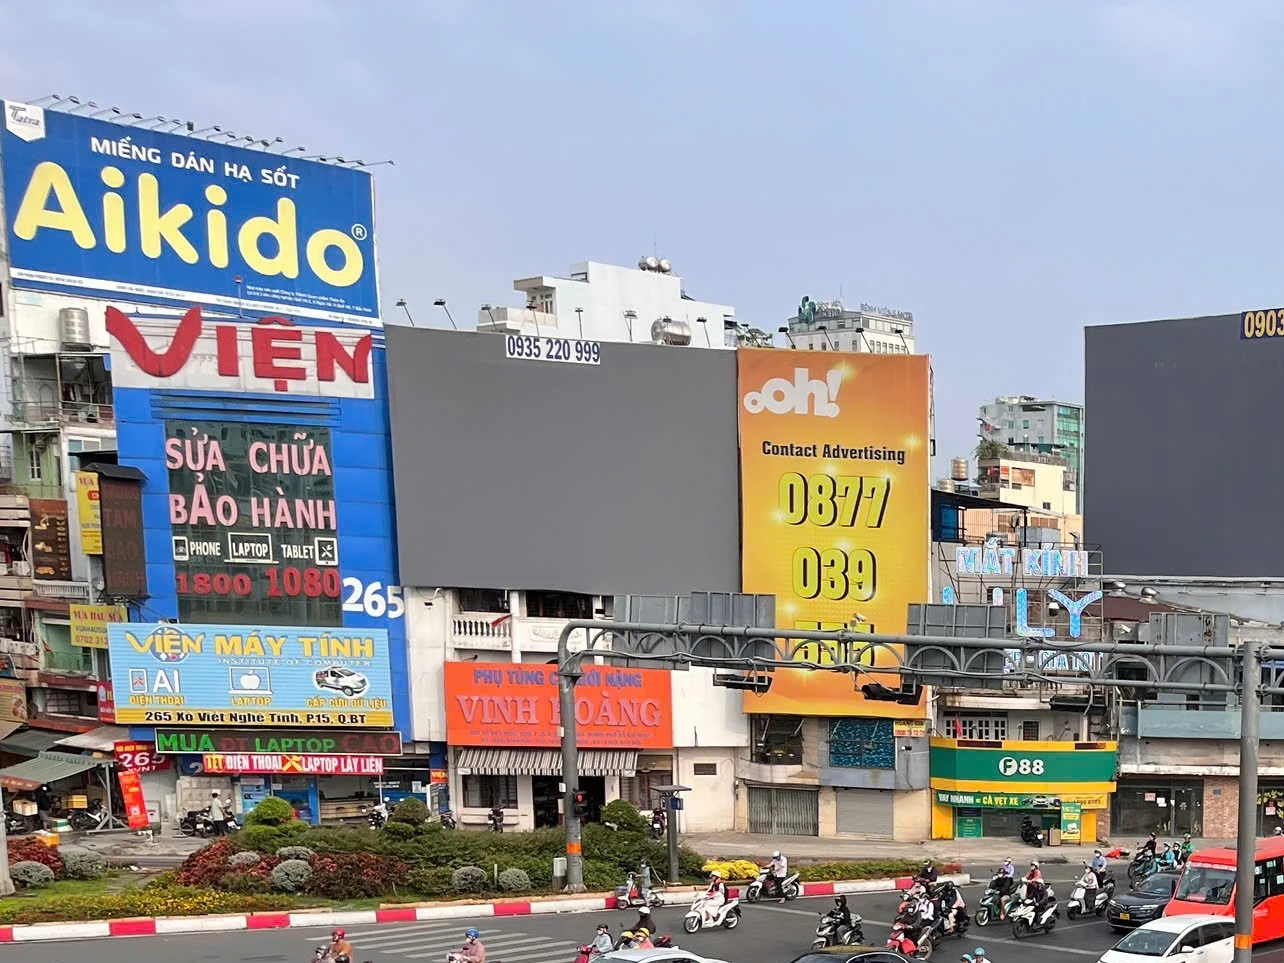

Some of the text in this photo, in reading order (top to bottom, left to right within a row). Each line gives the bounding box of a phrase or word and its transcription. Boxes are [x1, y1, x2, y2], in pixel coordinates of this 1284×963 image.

[90, 136, 300, 189] MIẾNG DÁN HẠ SỐT
[13, 161, 364, 288] Aikido
[105, 305, 373, 392] VIỆN
[507, 335, 600, 362] 0935 220 999
[165, 427, 332, 476] SỬA CHỮA
[762, 441, 905, 464] Contact Advertising
[169, 472, 337, 530] BẢO HÀNH
[778, 472, 891, 528] 0877
[190, 541, 314, 559] PHONE LAPTOP TABLET
[1022, 542, 1089, 577] KÍNH
[176, 568, 341, 597] 1800 1080
[792, 547, 877, 601] 039
[342, 577, 405, 618] 265
[214, 630, 287, 657] MÁY
[298, 632, 375, 657] TÍNH
[474, 669, 503, 688] PHỤ
[507, 666, 544, 685] TÙNG
[129, 694, 185, 706] ĐIỆN THOẠI
[231, 696, 272, 706] LAPTOP
[456, 695, 538, 724] VINH
[145, 711, 171, 721] 265
[338, 714, 366, 724] Q.BT
[157, 734, 216, 752] MUA
[255, 738, 335, 752] LAPTOP
[119, 752, 166, 768] 265
[226, 755, 249, 772] ĐIỆN
[253, 755, 282, 773] THOẠI
[302, 757, 338, 772] LAPTOP
[998, 756, 1044, 776] F88
[950, 794, 974, 804] NHANH
[1009, 797, 1020, 805] XE
